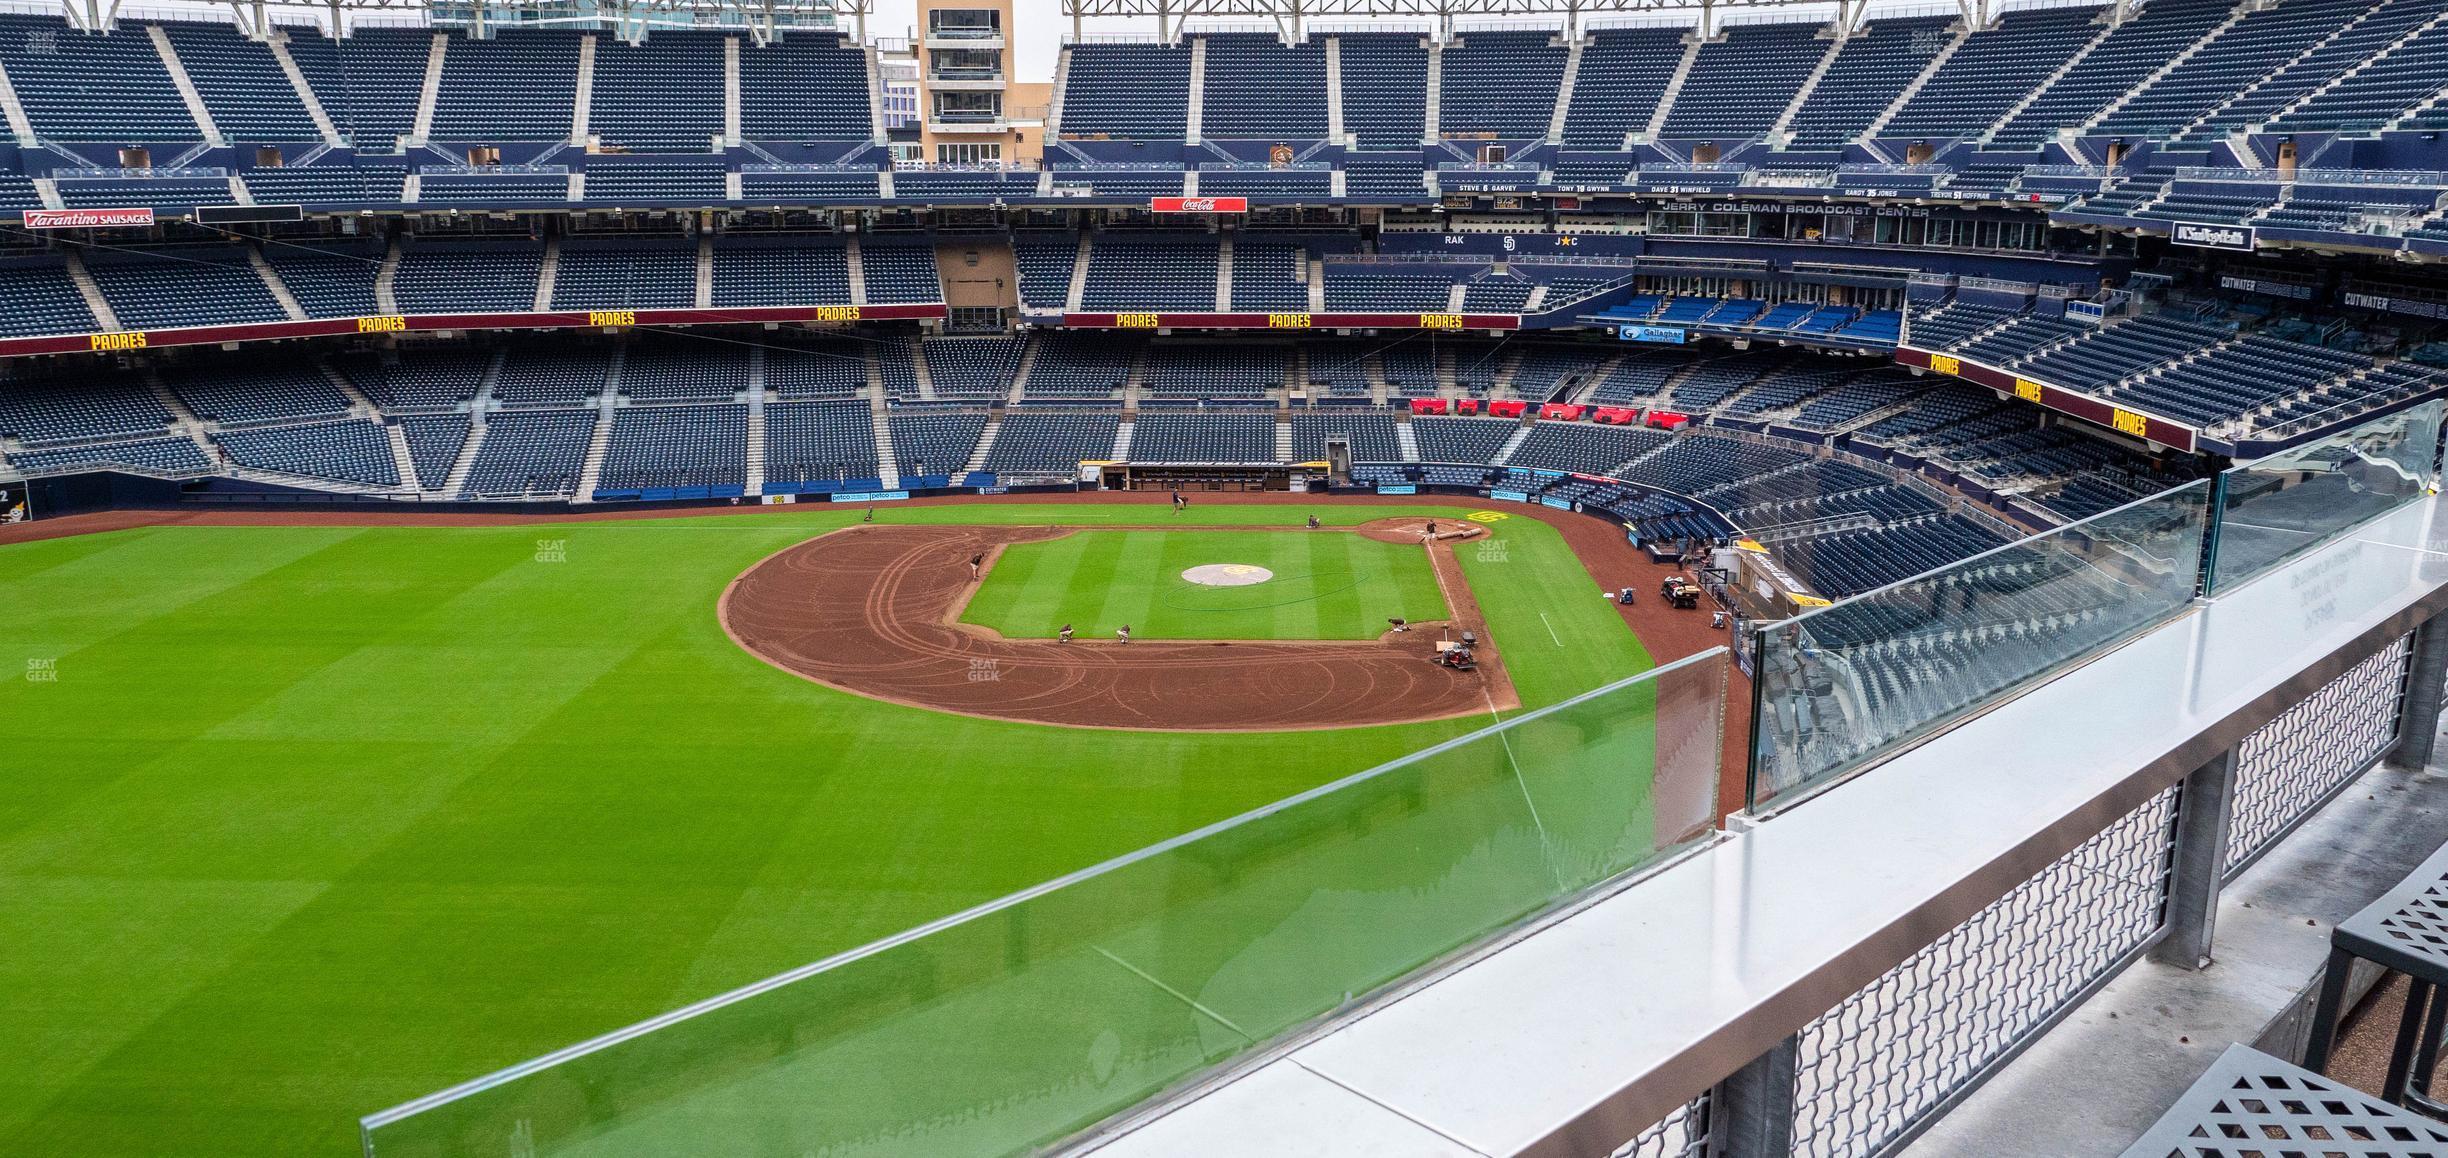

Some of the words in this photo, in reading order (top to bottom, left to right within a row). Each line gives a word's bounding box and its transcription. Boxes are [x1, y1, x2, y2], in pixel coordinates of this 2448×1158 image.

[1576, 185, 1585, 193] 19
[1669, 186, 1679, 194] 31
[1866, 189, 1877, 197] 35
[1663, 202, 1706, 211] JERRY
[1713, 203, 1780, 213] COLEMAN
[1786, 204, 1871, 216] BROADCAST
[1876, 207, 1930, 217] CENTER
[28, 213, 98, 226] Tarantino
[100, 214, 152, 224] SAUSAGES
[1445, 235, 1464, 244] RAK
[2221, 276, 2257, 292] CUTWATER
[2344, 292, 2389, 311] CUTWATER
[590, 311, 635, 326] PADRES
[817, 306, 860, 320] PADRES
[1116, 313, 1158, 327] PADRES
[358, 316, 406, 333] PADRES
[1269, 314, 1311, 328] PADRES
[1420, 314, 1462, 328] PADRES
[91, 332, 147, 350] PADRES
[1930, 354, 1959, 375] PADRES
[2015, 377, 2042, 403] PADRES
[2112, 408, 2147, 437] PADRES
